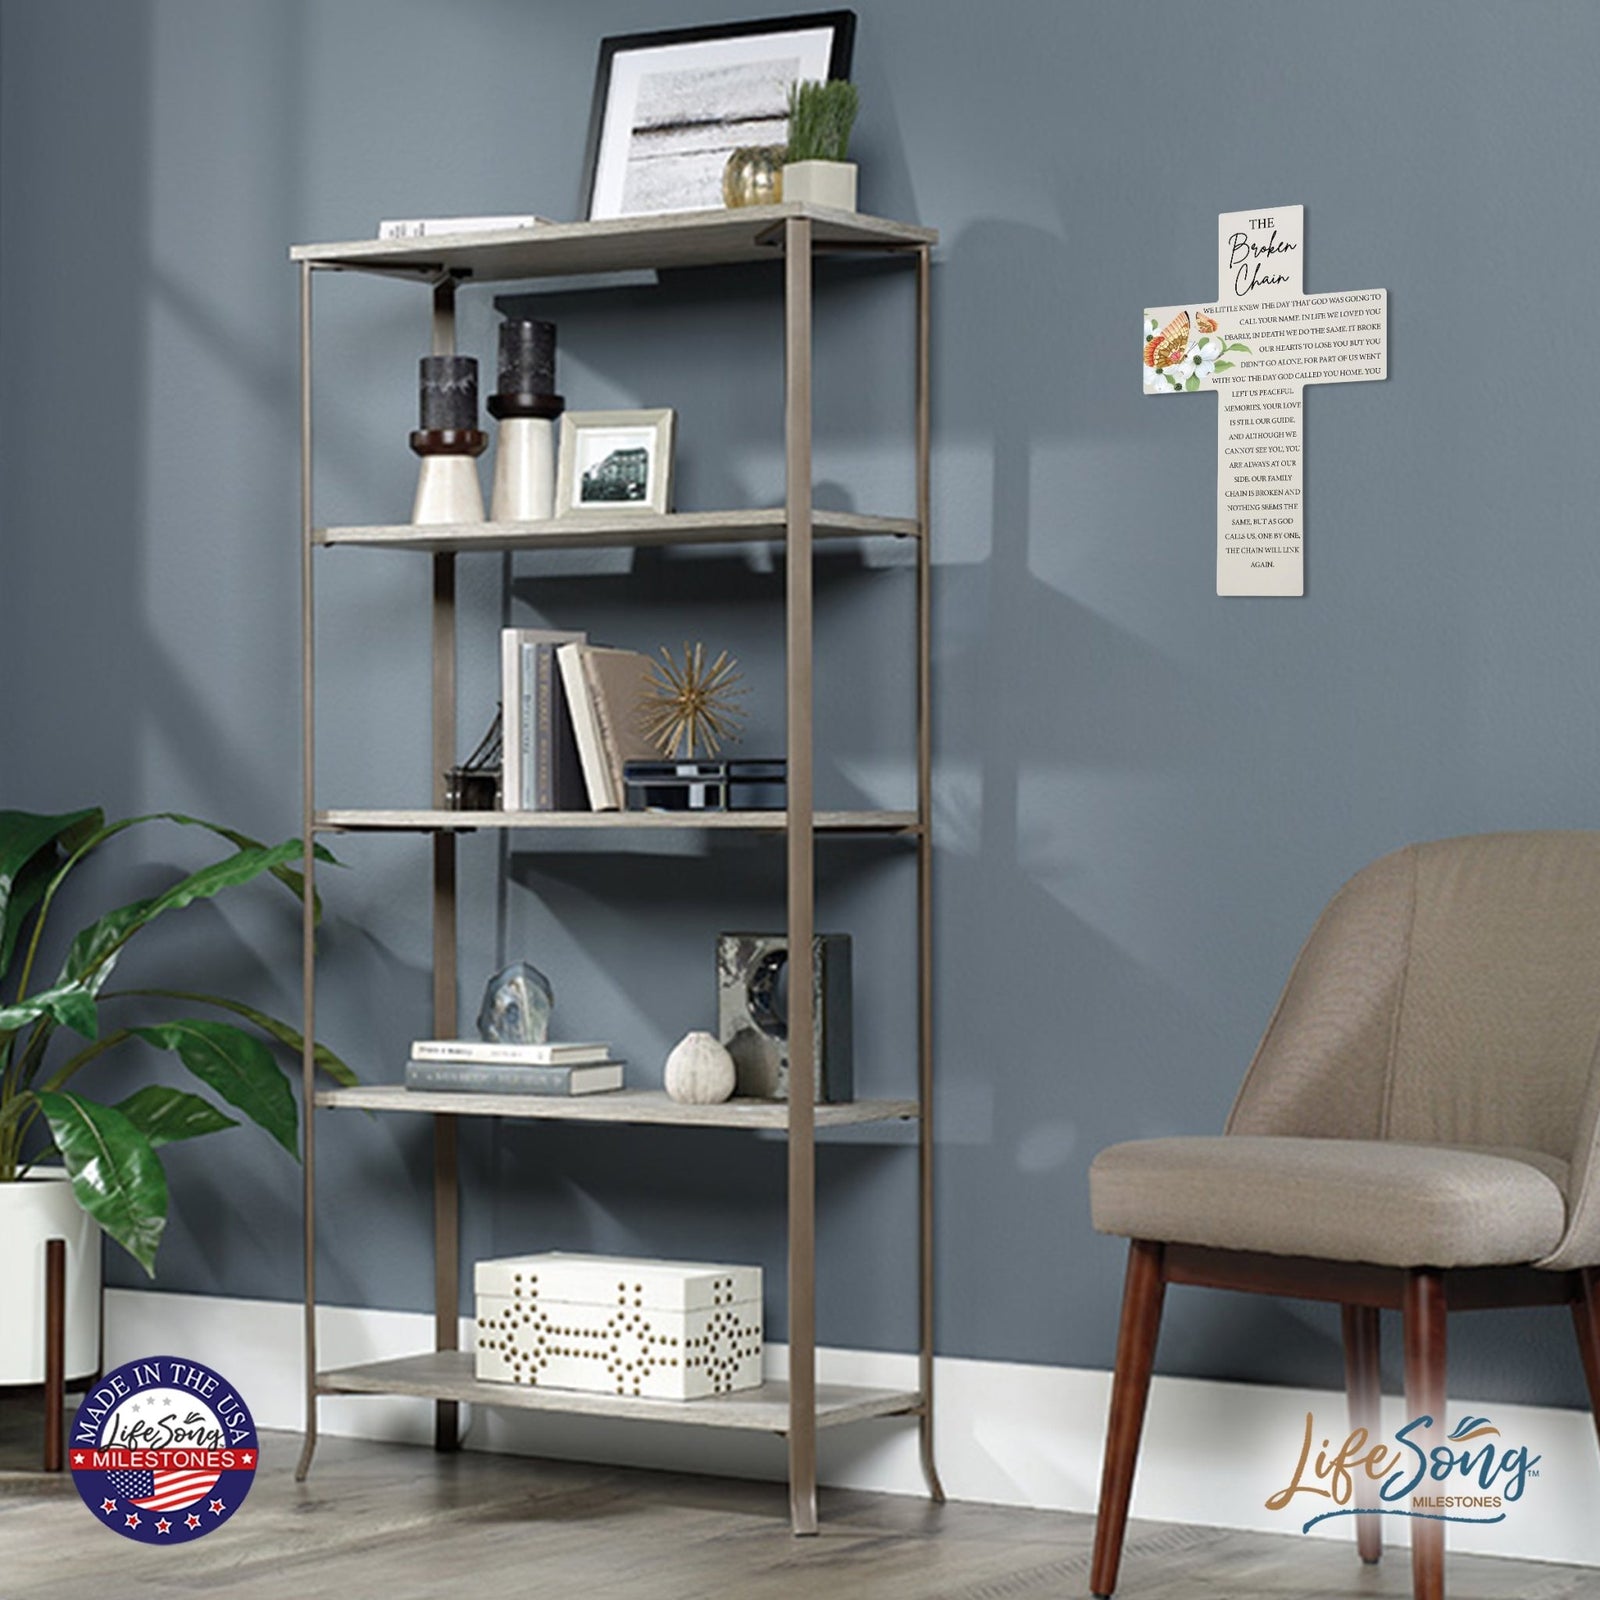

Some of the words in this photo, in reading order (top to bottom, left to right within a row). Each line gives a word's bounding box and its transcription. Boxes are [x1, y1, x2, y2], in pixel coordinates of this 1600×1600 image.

[1249, 218, 1275, 230] THE
[1228, 230, 1297, 269] Broken
[1235, 263, 1289, 296] Chain
[1239, 304, 1259, 312] KNEW
[1329, 296, 1344, 304] WAS
[1259, 388, 1294, 396] PEACEFUL
[1225, 447, 1254, 455] CANNOT
